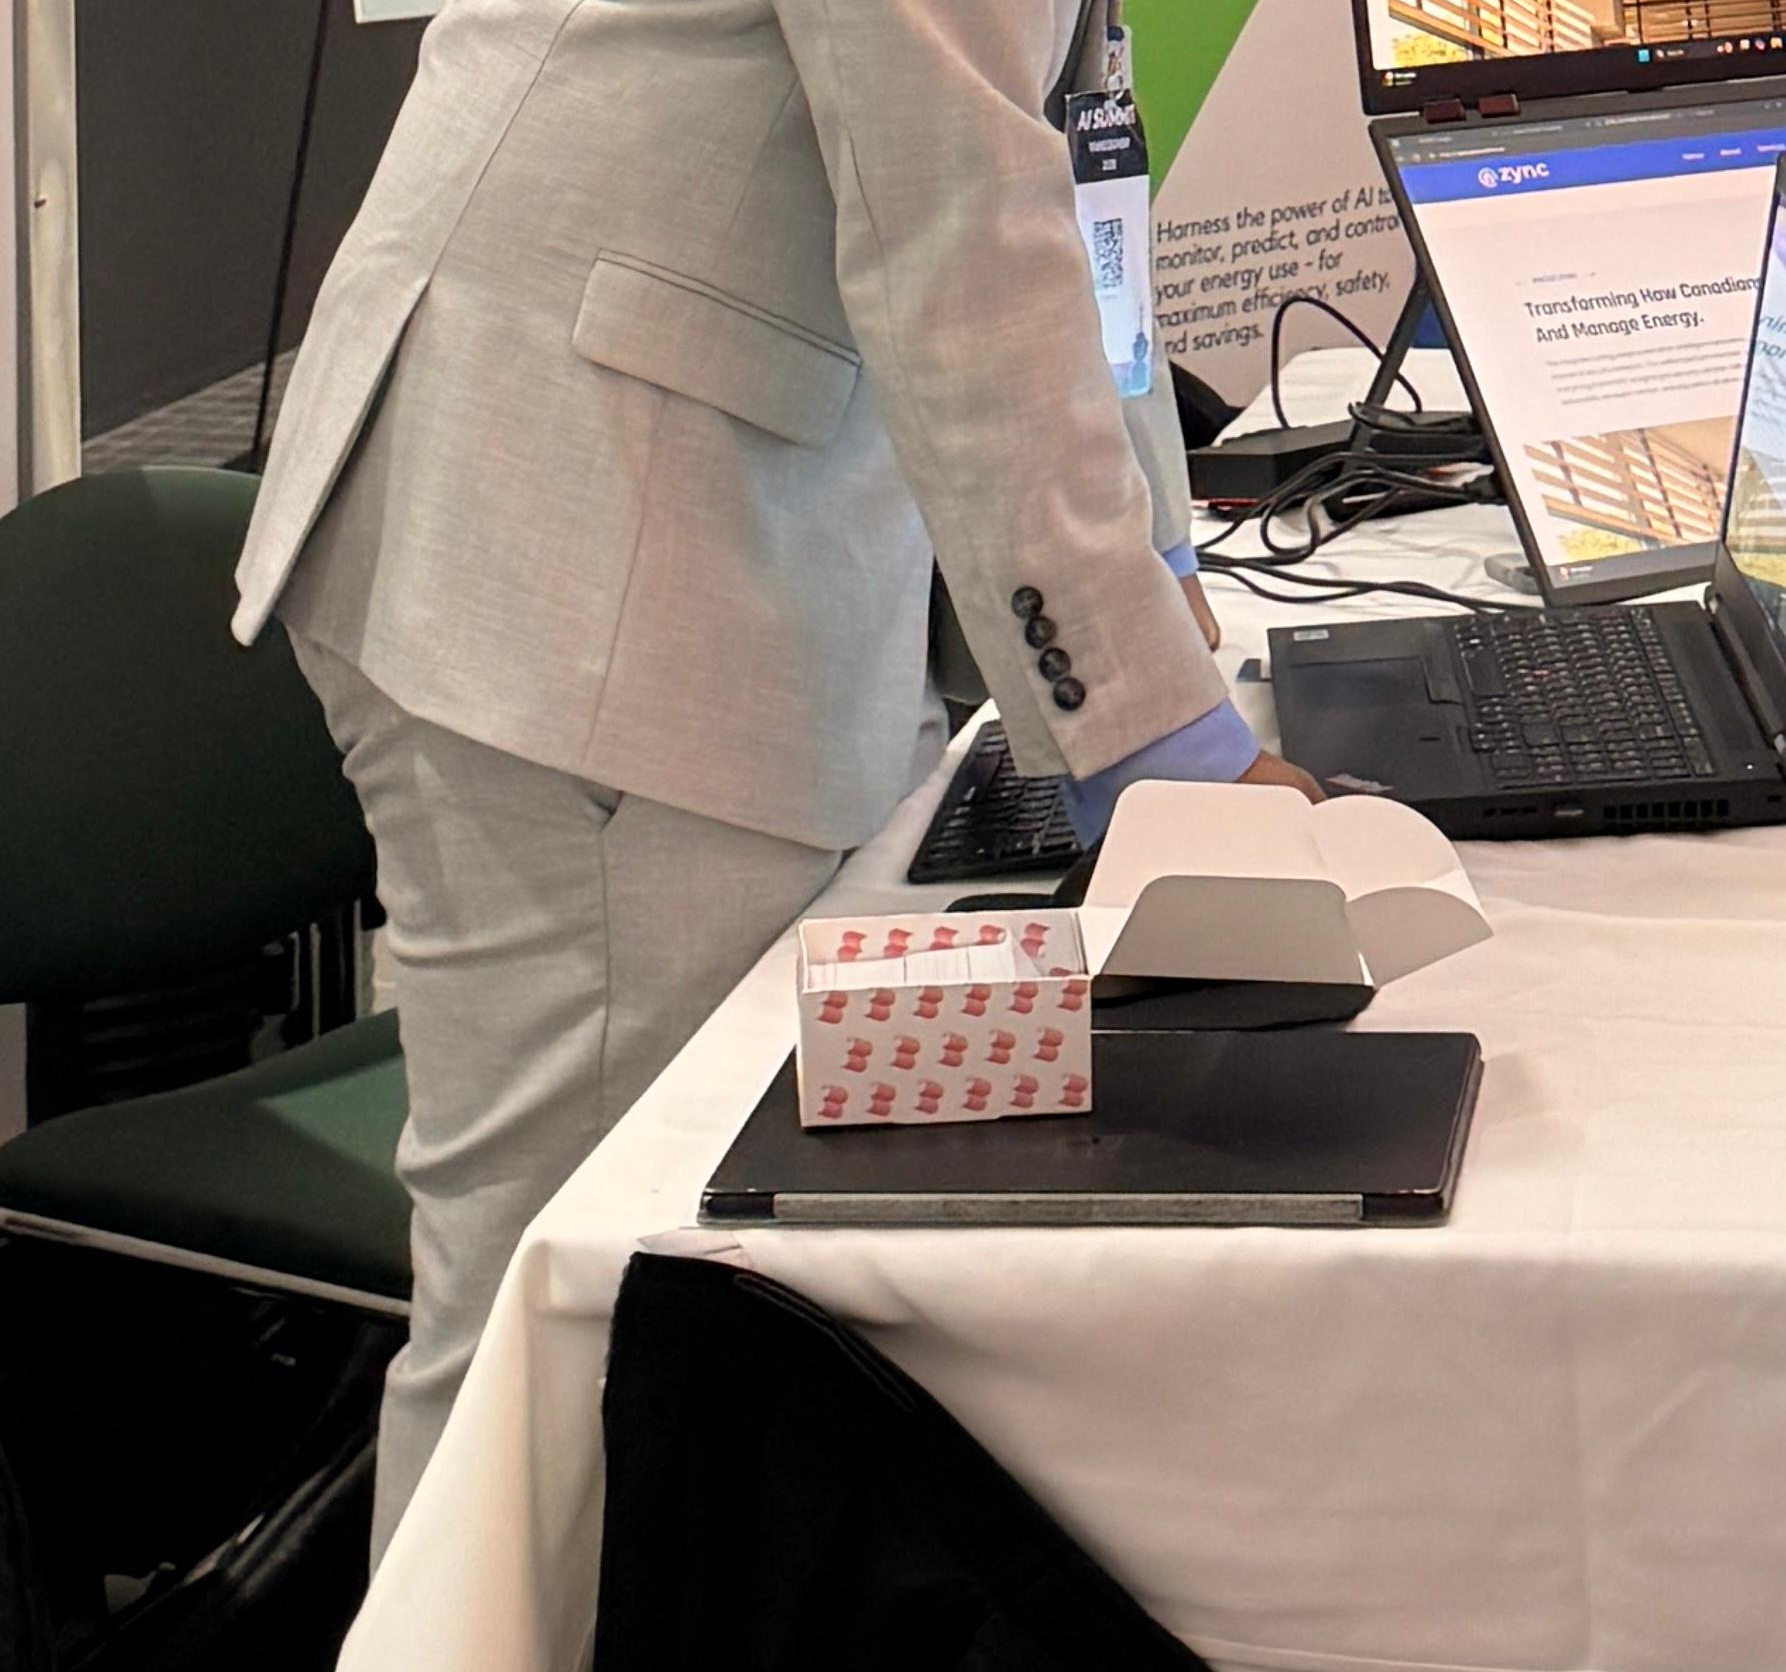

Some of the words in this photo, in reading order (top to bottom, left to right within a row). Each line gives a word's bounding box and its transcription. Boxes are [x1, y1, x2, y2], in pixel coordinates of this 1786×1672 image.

[1157, 216, 1231, 243] Harness
[1236, 206, 1265, 229] the
[1270, 200, 1327, 228] power
[1331, 188, 1350, 214] of
[1354, 186, 1374, 210] AI
[1156, 243, 1226, 271] monitor,
[1231, 229, 1299, 264] predict,
[1306, 217, 1341, 246] and
[1345, 213, 1400, 239] contro
[1156, 278, 1195, 305] your
[1201, 266, 1264, 291] energy
[1268, 261, 1299, 280] use
[1318, 248, 1343, 271] for
[1524, 289, 1639, 319] Transforming
[1639, 286, 1677, 303] How
[1165, 329, 1187, 354] nd
[1193, 322, 1264, 350] savings.
[1536, 322, 1570, 344] And
[1571, 318, 1640, 340] Manage
[1641, 309, 1705, 331] Energy.
